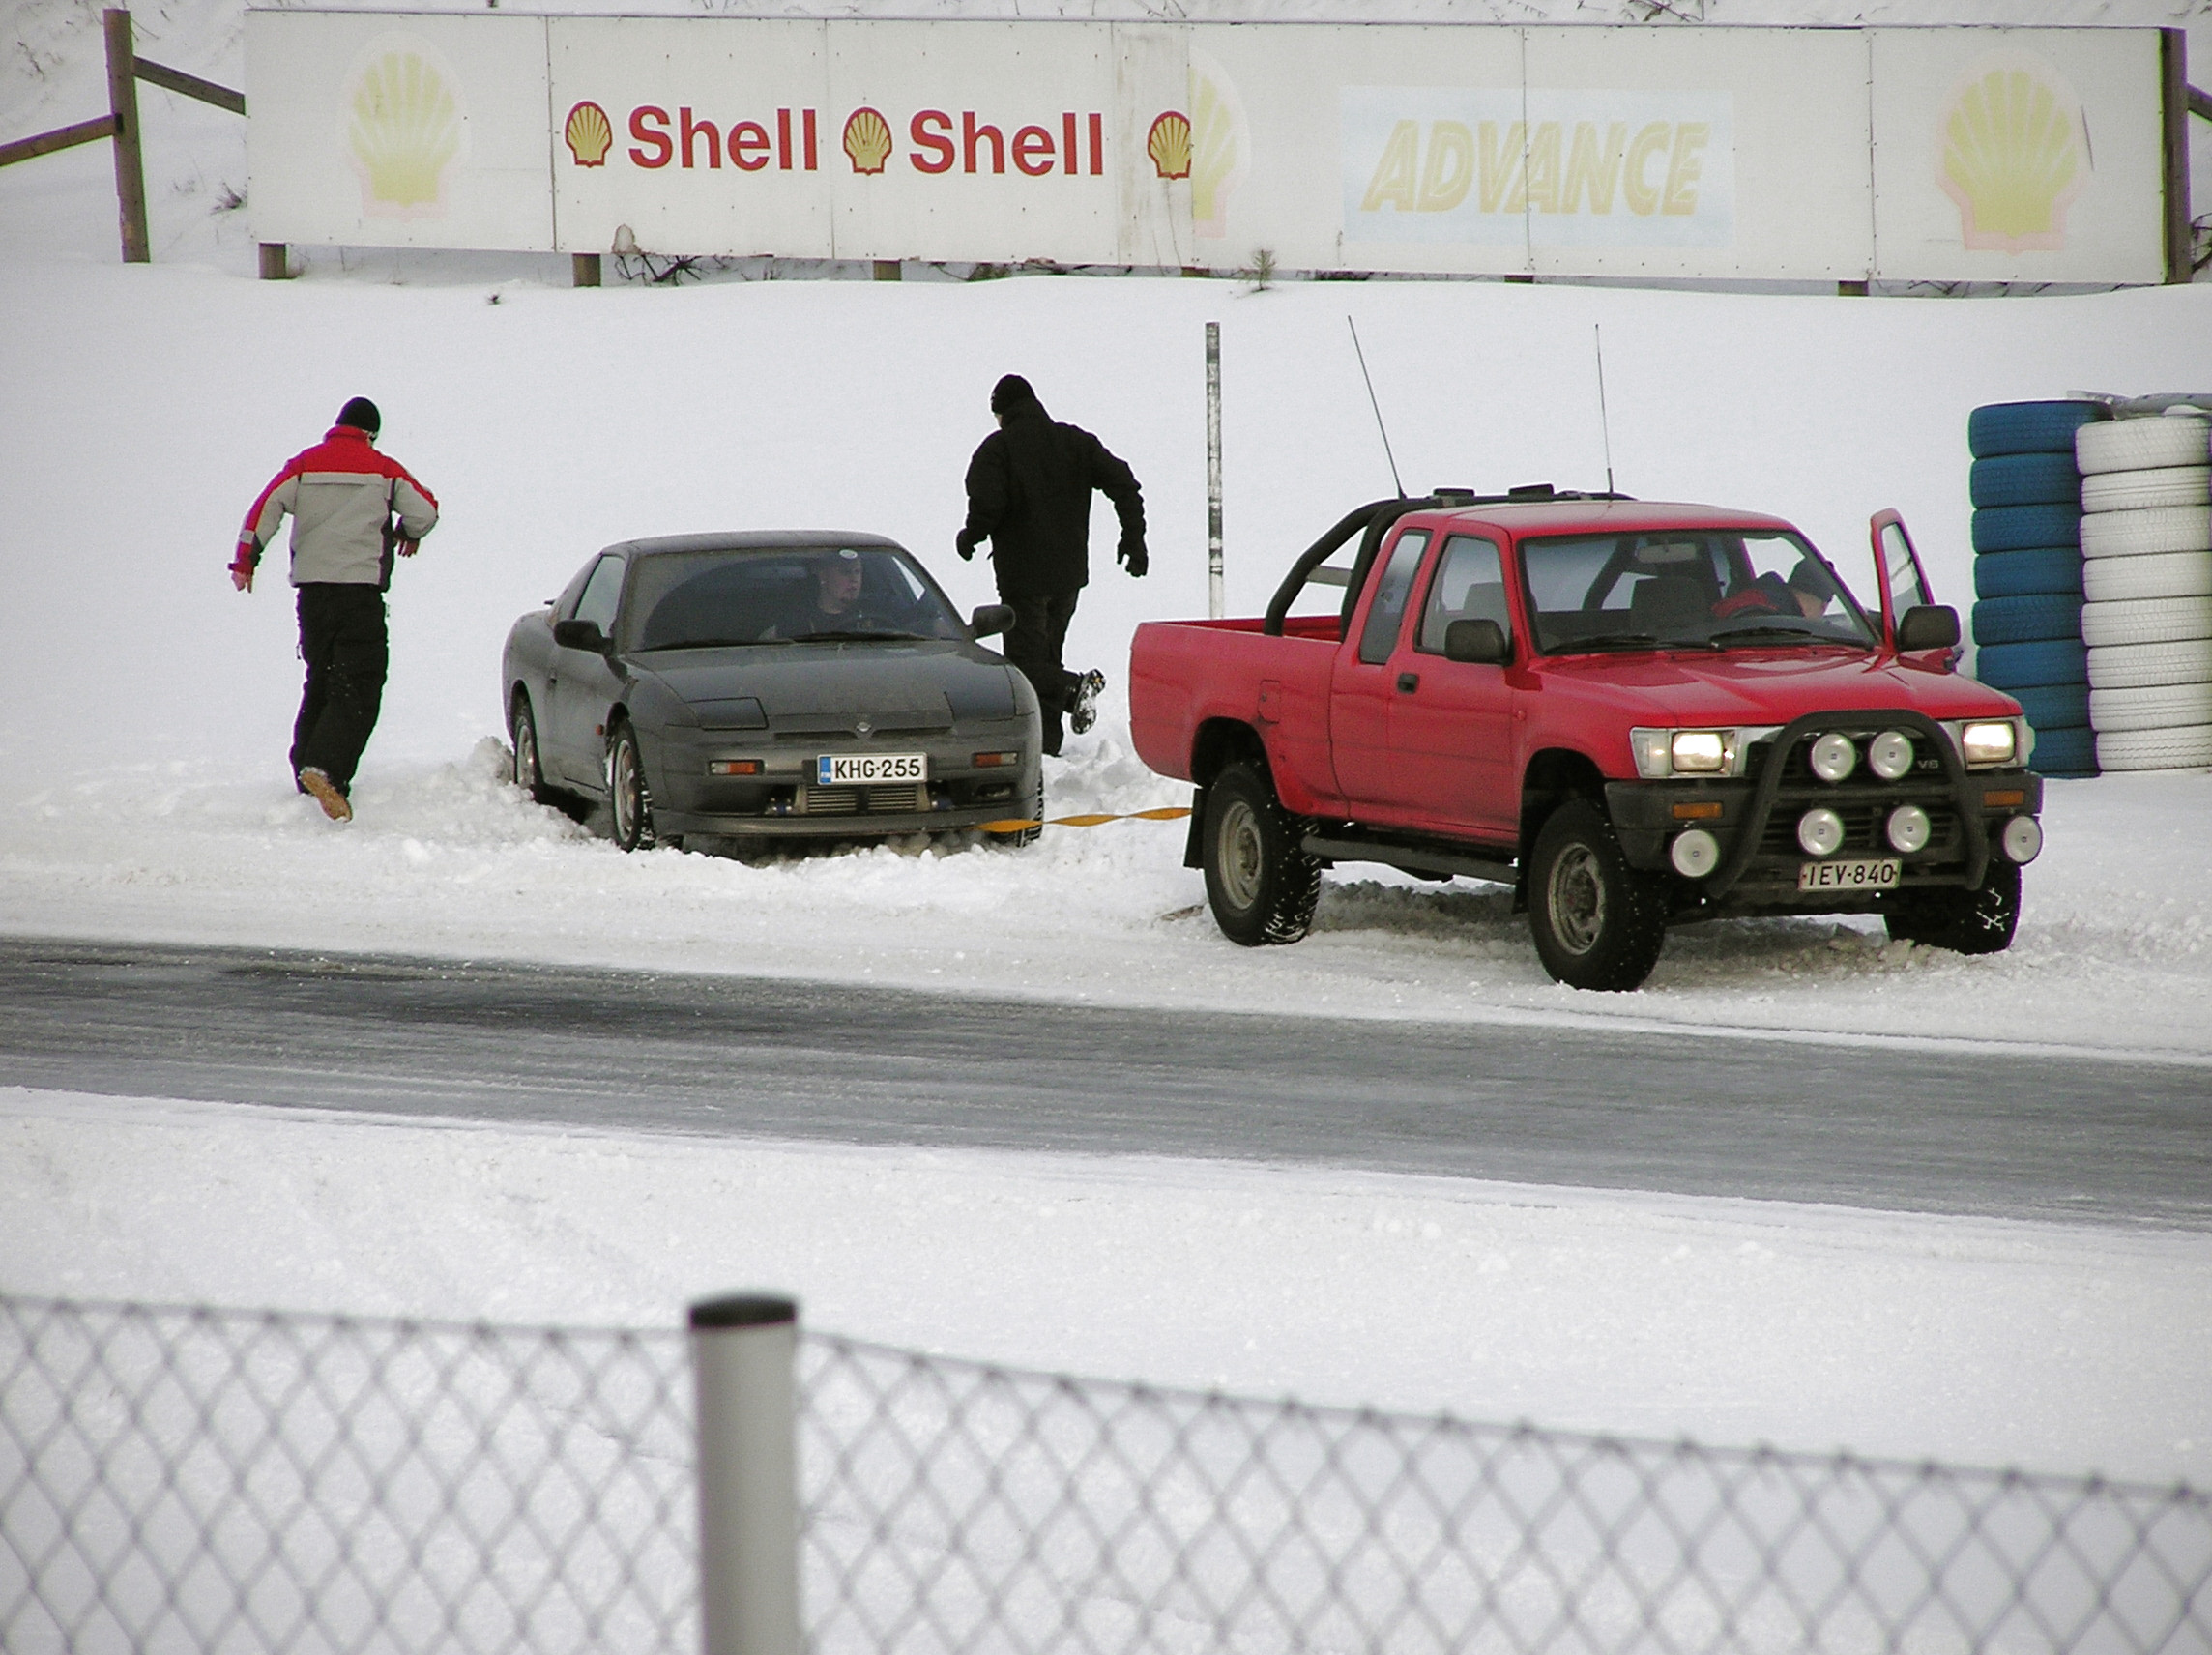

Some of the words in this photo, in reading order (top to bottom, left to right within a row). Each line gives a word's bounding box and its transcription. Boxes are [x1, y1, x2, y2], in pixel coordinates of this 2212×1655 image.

[628, 105, 817, 170] Shell
[909, 109, 1104, 176] Shell
[1359, 119, 1711, 216] ADVANCE
